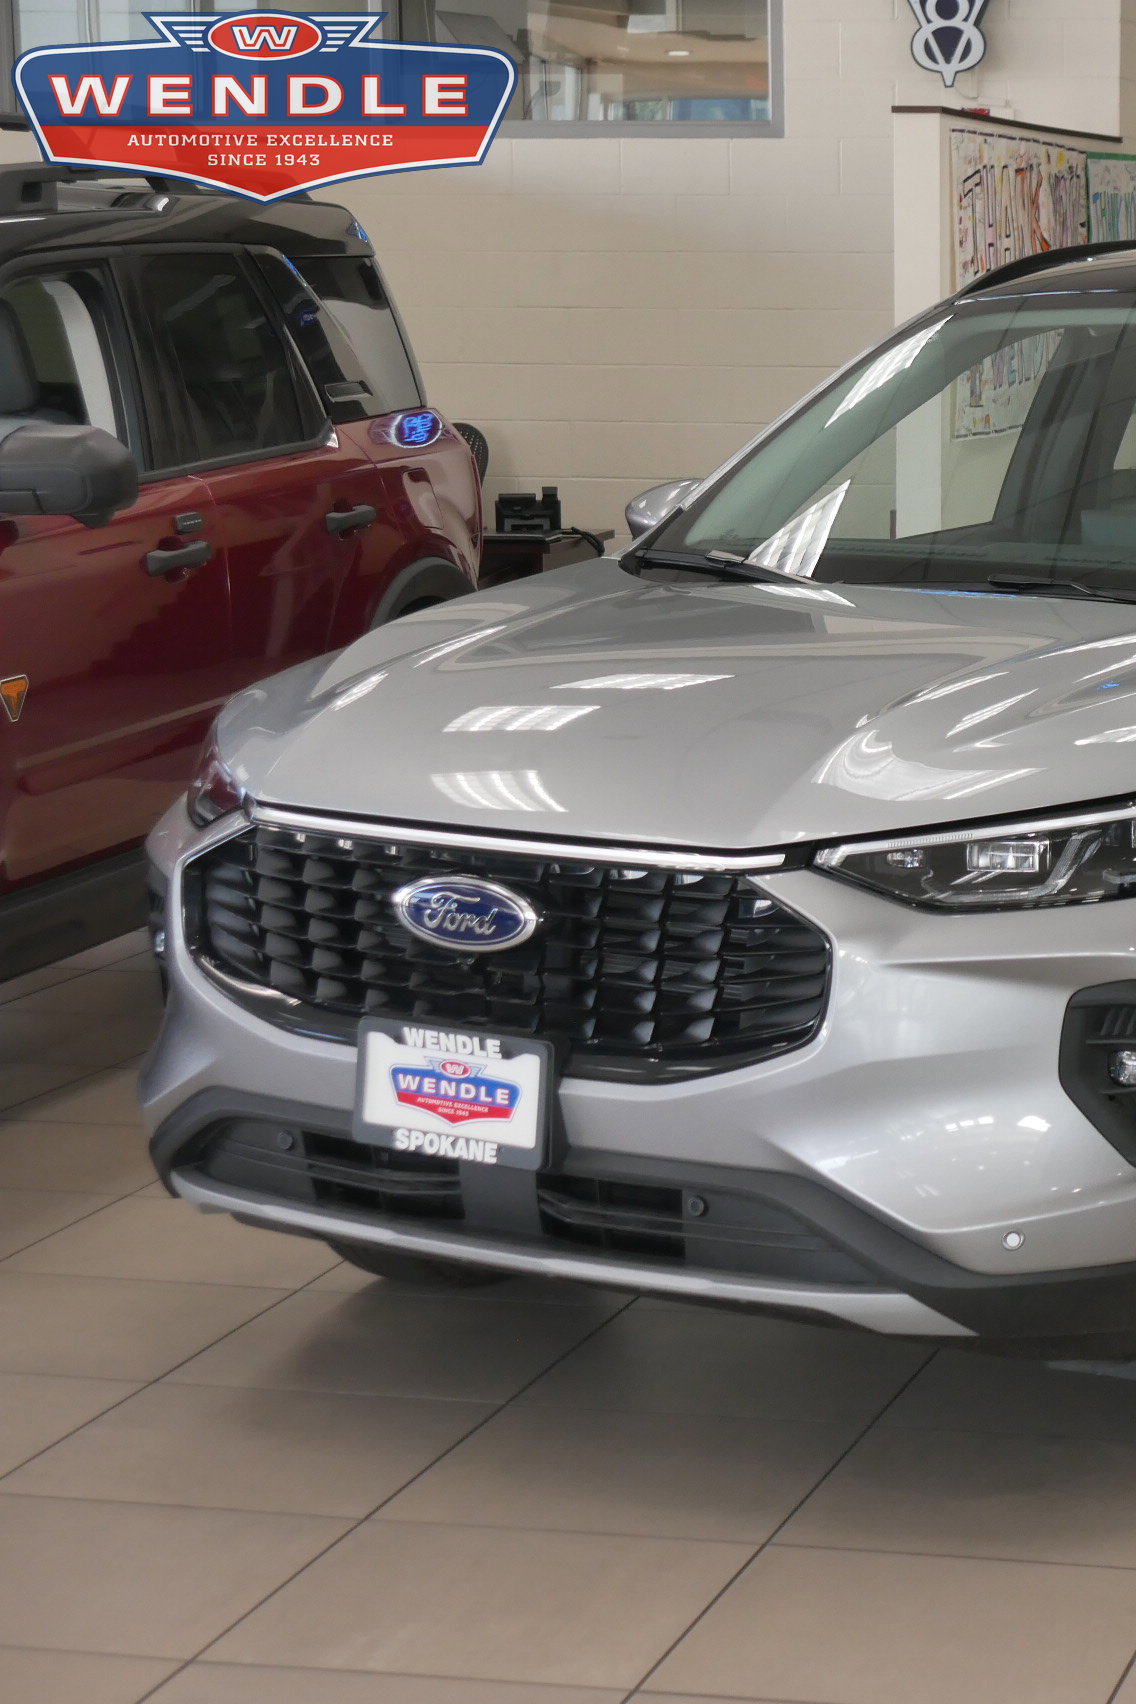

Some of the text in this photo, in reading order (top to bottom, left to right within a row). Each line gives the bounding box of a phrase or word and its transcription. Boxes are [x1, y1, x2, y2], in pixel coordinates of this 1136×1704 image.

[423, 891, 499, 935] Ford
[403, 1027, 502, 1059] WENDLE
[398, 1073, 510, 1105] WENDLE
[416, 1096, 453, 1108] AUTOMOTIVE
[393, 1128, 498, 1164] SPOKANE
